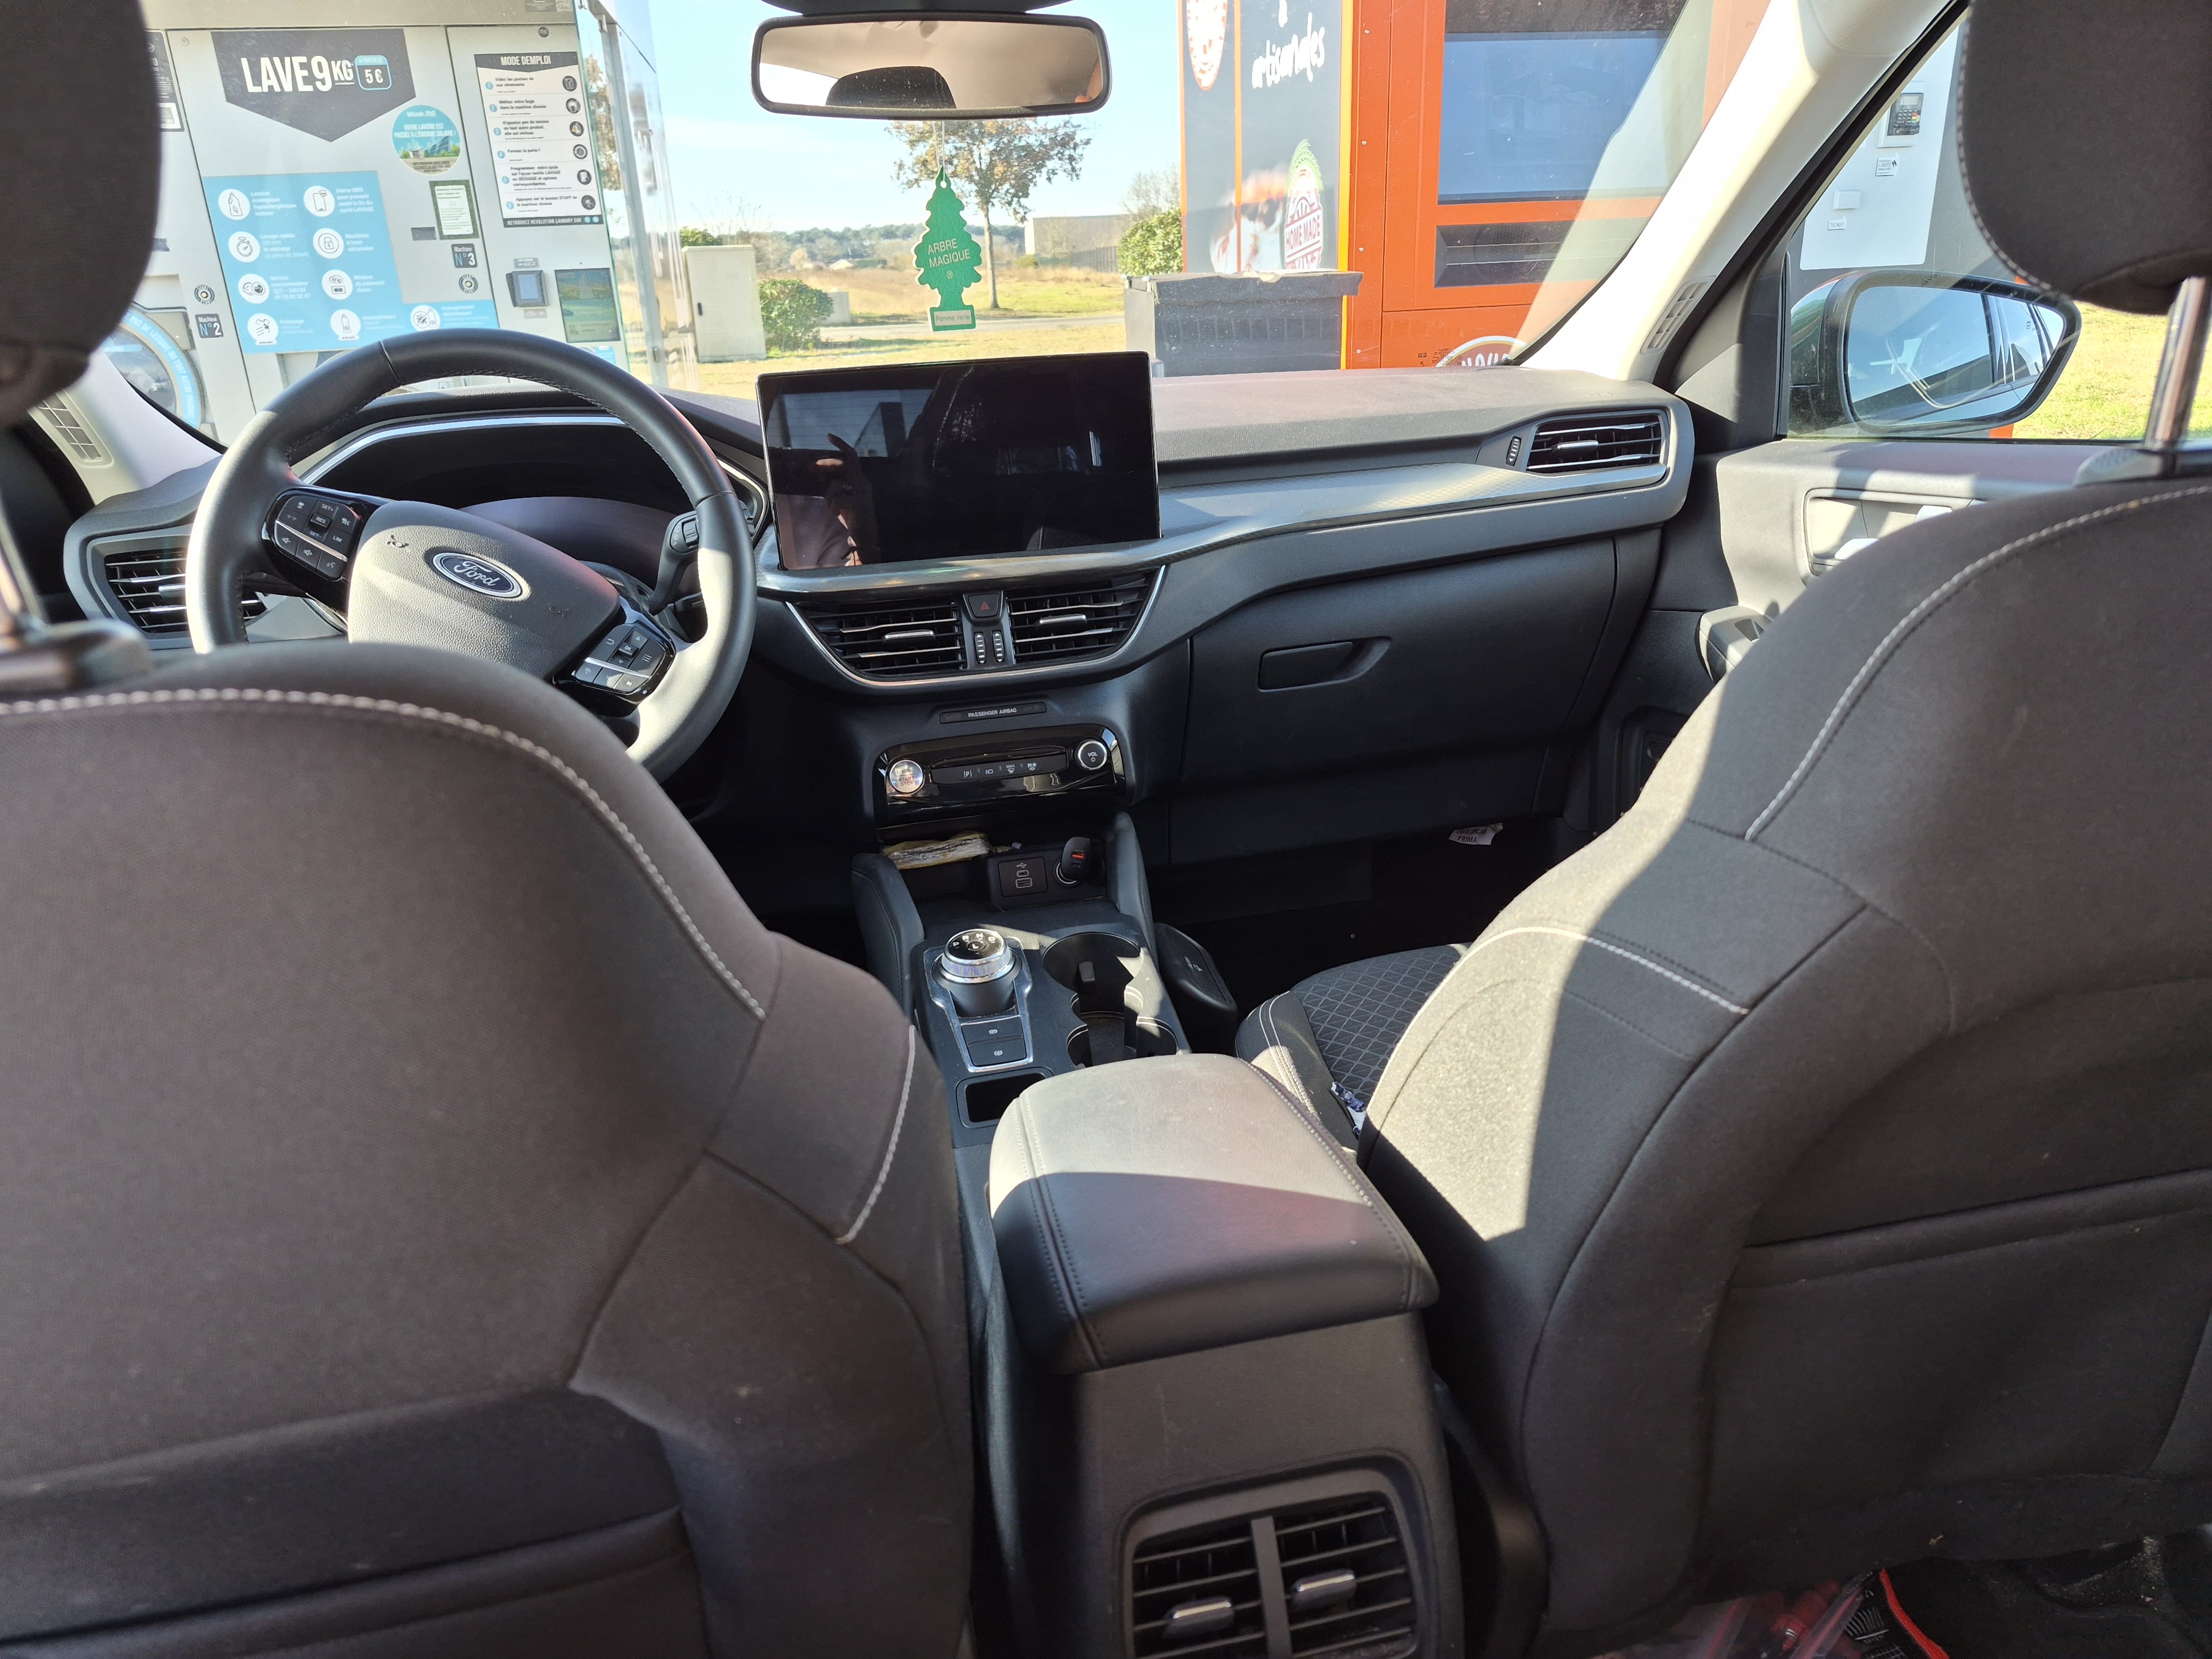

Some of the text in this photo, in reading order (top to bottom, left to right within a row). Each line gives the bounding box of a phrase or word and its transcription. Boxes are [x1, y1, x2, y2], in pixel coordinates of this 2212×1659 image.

[1252, 12, 1325, 88] artisanales
[500, 56, 520, 66] MODE
[1286, 215, 1320, 252] HOME MADE
[927, 238, 957, 255] ARBRE
[929, 249, 971, 268] MAGIQUE
[936, 311, 971, 322] Pomme Verte
[453, 561, 500, 586] Ford
